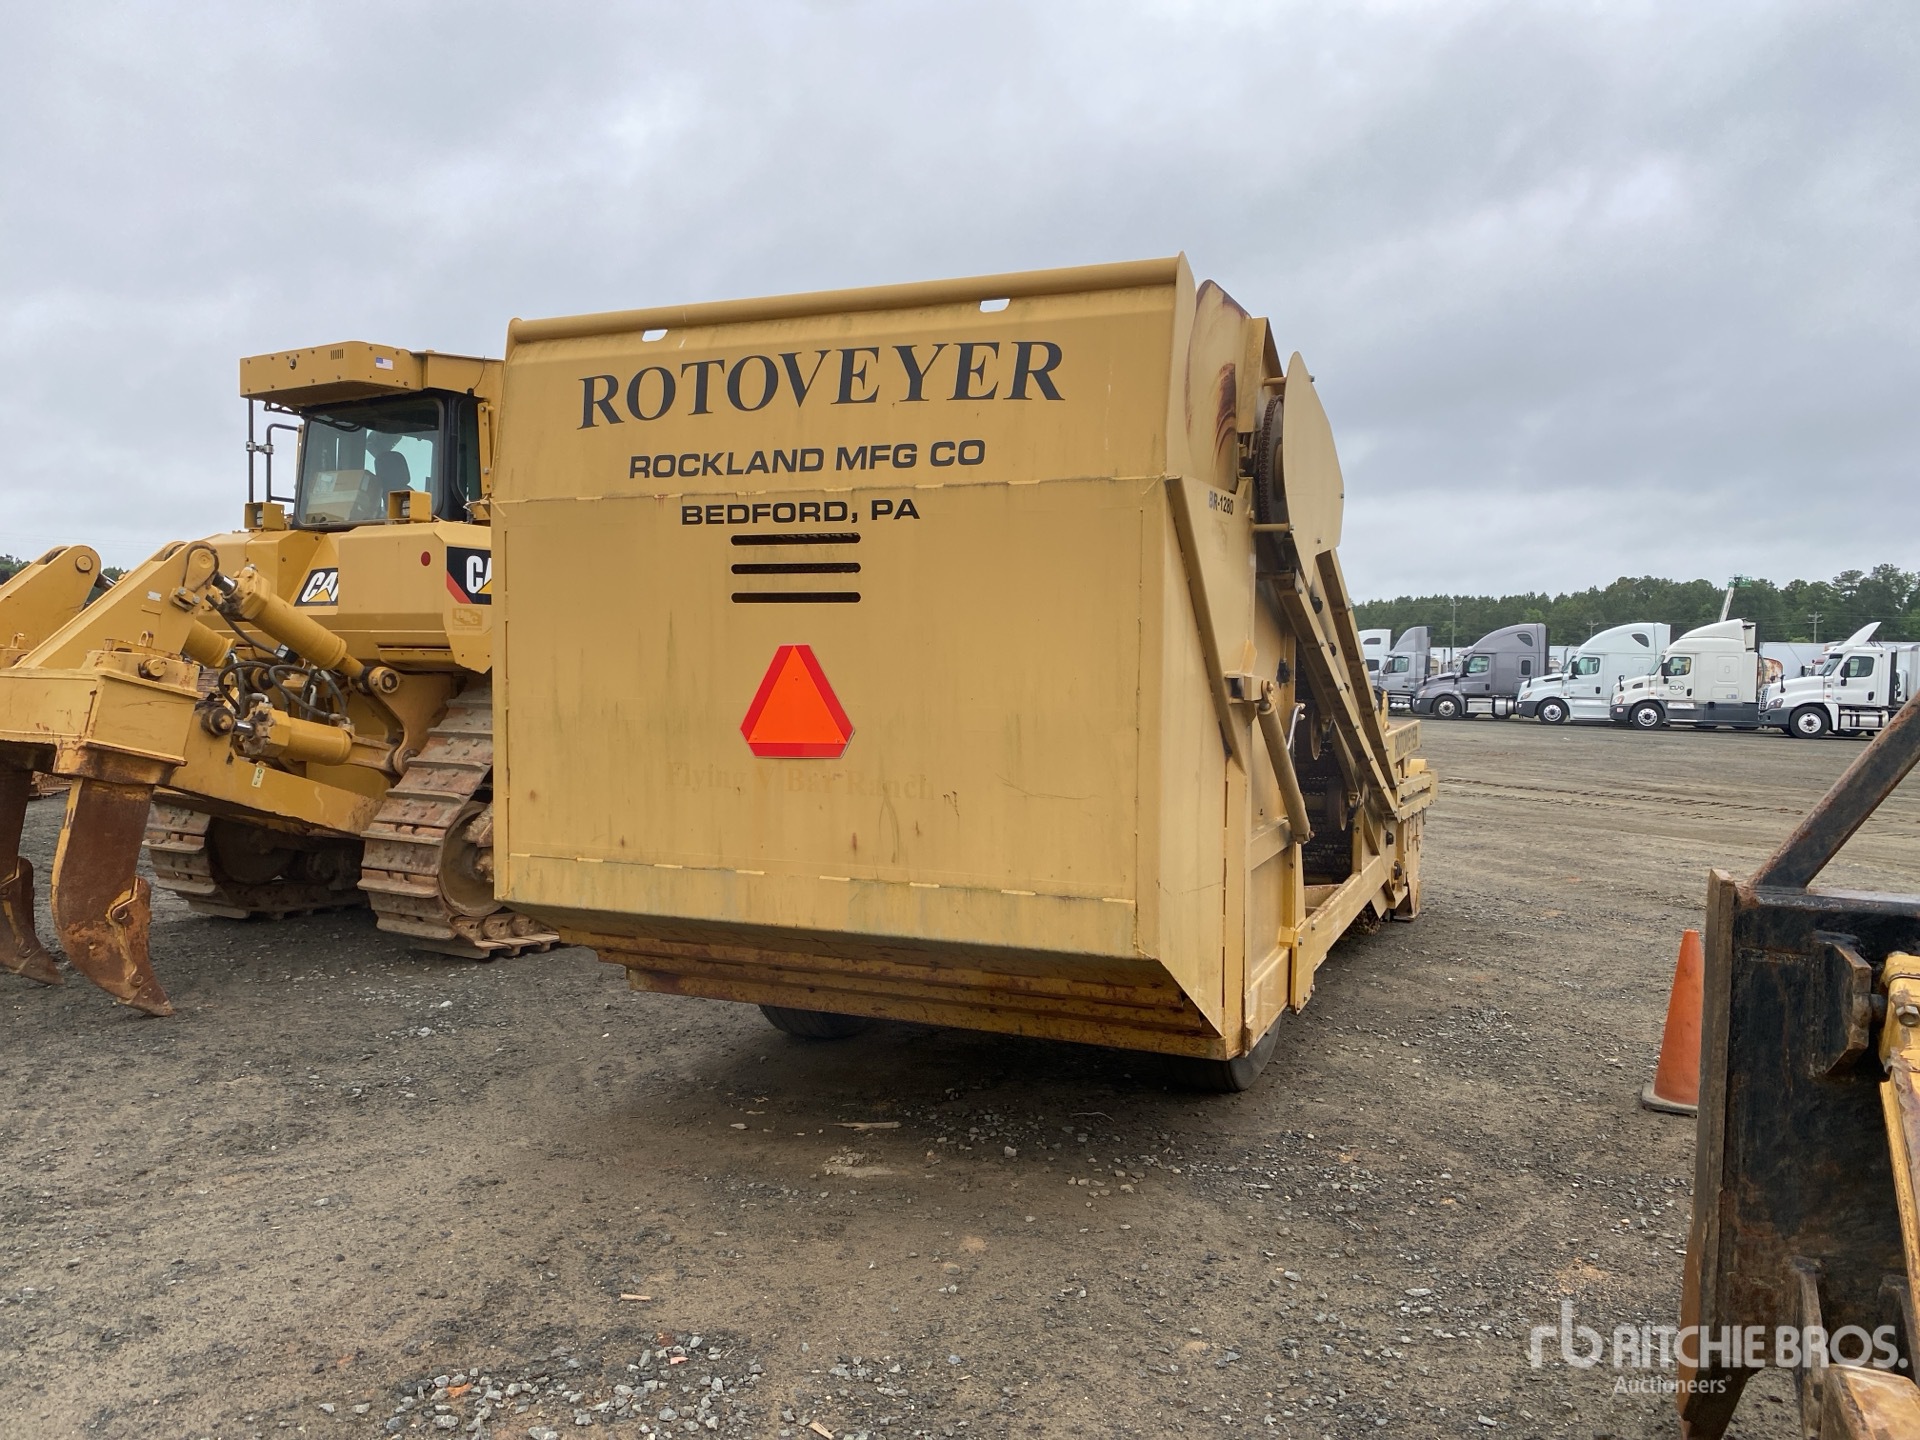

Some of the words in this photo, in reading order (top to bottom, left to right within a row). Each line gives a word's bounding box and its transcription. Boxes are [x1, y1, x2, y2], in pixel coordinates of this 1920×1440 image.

[577, 341, 1066, 430] ROTOVEYER
[629, 448, 825, 479] ROCKLAND
[835, 443, 918, 471] MFG
[929, 439, 986, 466] CO
[681, 500, 858, 525] BEDFORD,
[871, 498, 920, 521] PA
